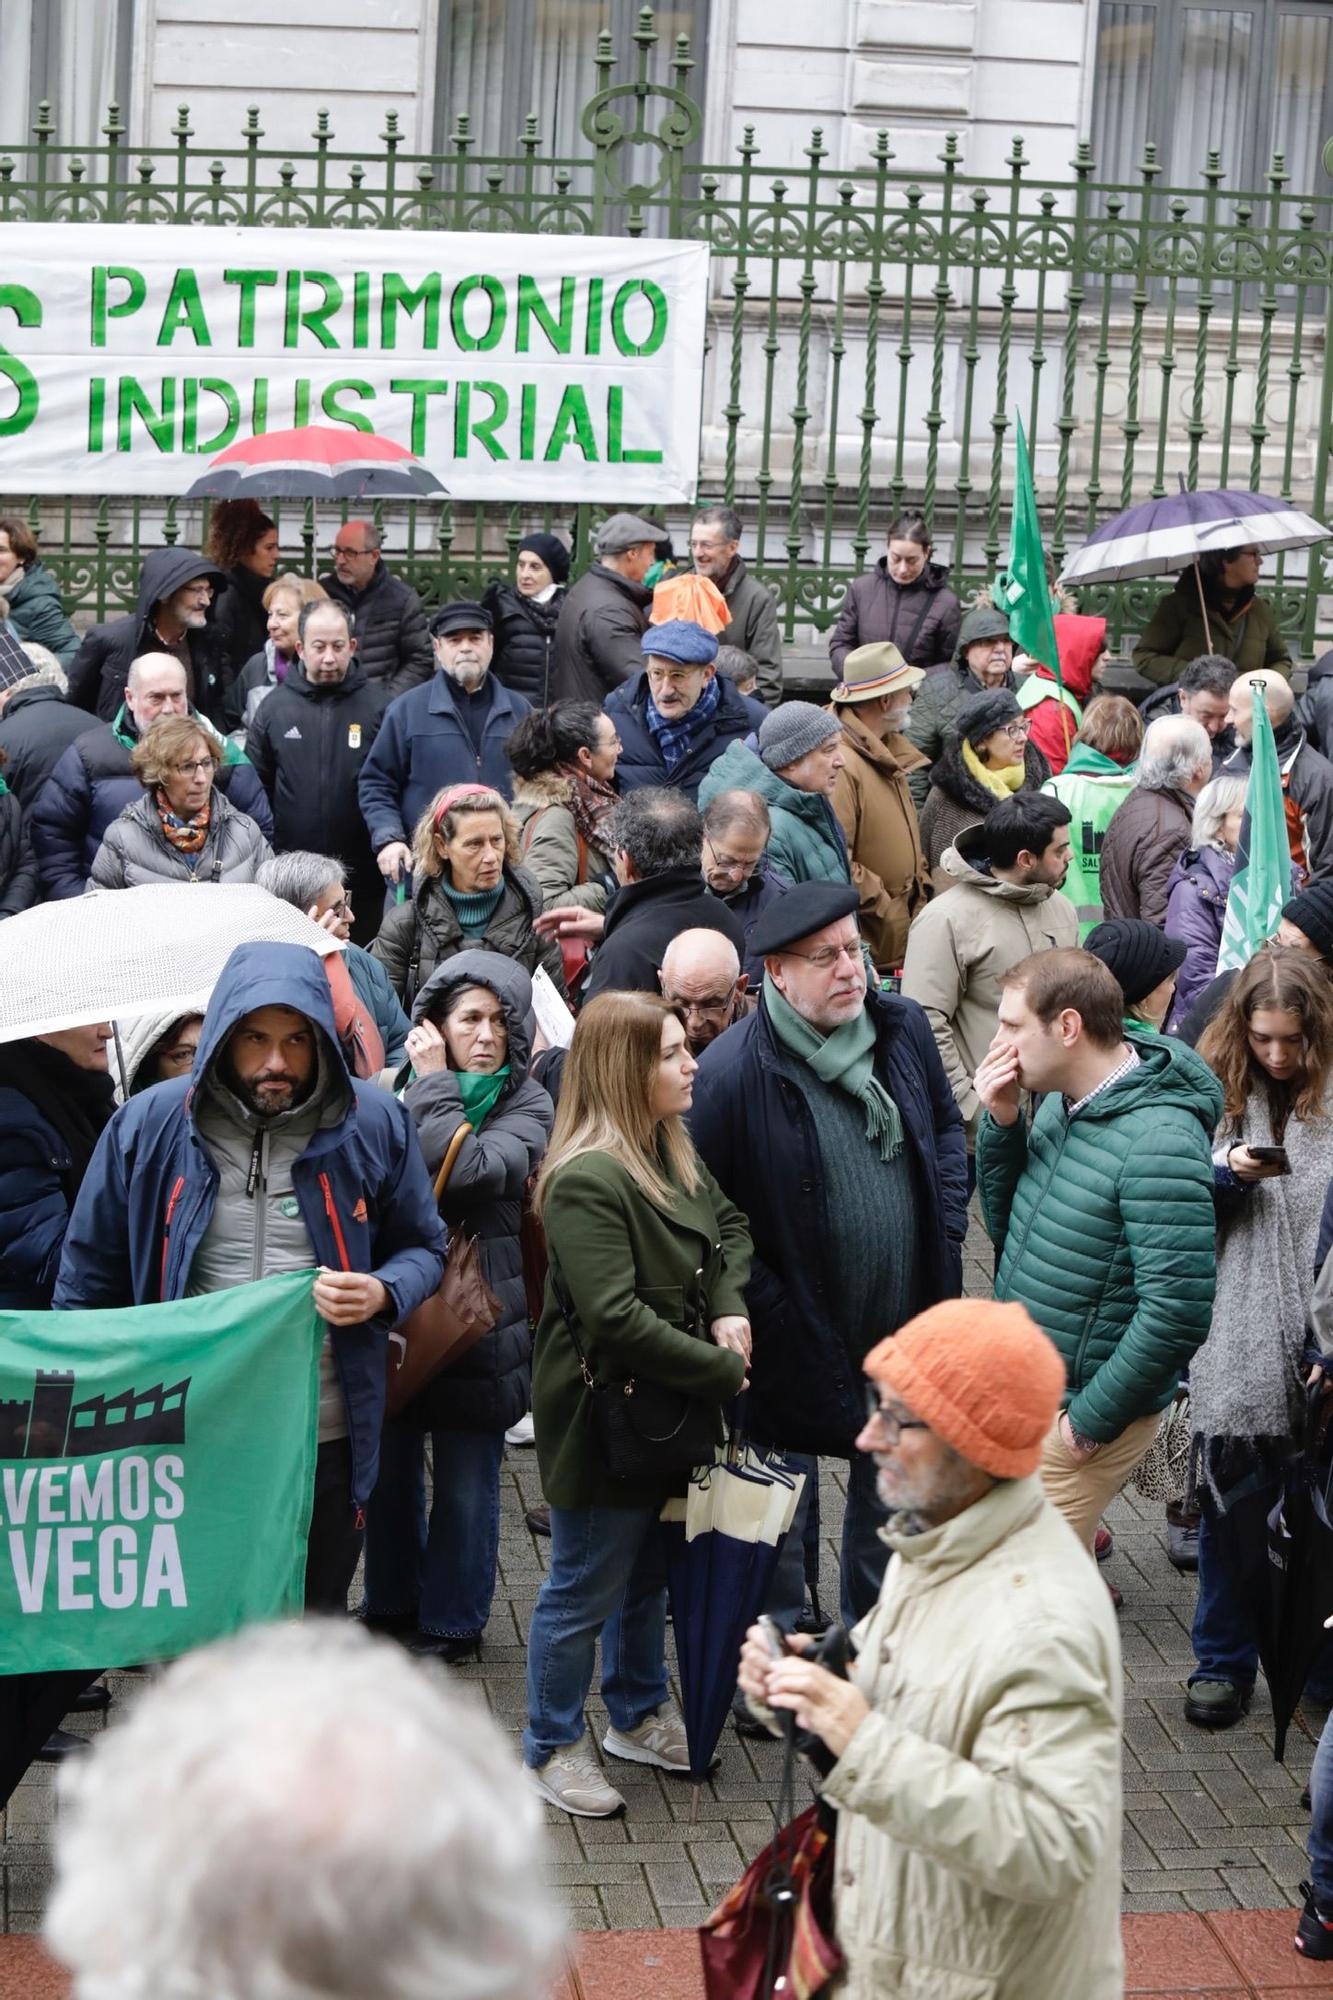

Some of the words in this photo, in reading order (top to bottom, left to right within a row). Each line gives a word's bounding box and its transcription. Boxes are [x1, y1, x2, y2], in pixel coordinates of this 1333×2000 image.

[91, 265, 669, 358] PATRIMONIO
[88, 374, 664, 465] INDUSTRIAL
[1082, 857, 1099, 868] SAL
[0, 1455, 185, 1525] VEMOS
[8, 1523, 188, 1613] VEGA
